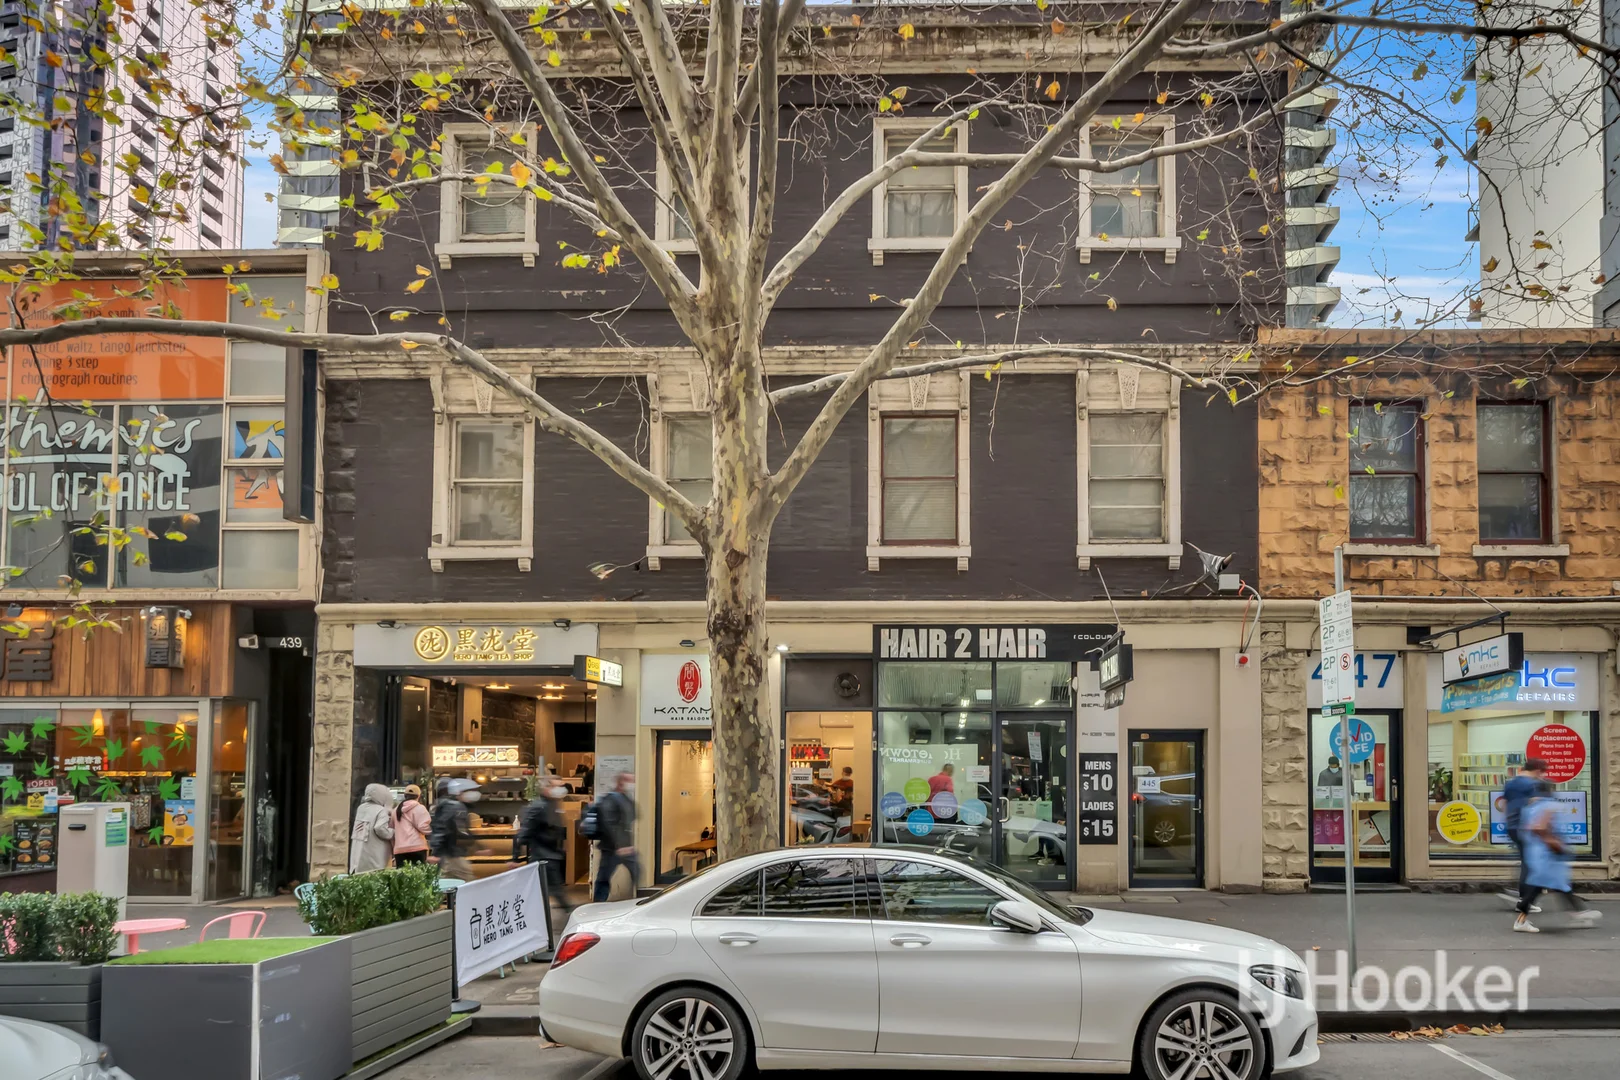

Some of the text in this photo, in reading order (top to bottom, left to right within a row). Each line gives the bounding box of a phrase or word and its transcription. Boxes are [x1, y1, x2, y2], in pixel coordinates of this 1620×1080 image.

[135, 340, 186, 355] quickstep
[75, 357, 99, 370] step
[94, 372, 138, 385] routines
[51, 471, 87, 512] OF
[1322, 599, 1332, 613] 1P
[1322, 625, 1335, 640] 2P
[280, 637, 302, 648] 439
[880, 628, 1047, 658] HAIR 2 HAIR
[1323, 655, 1336, 670] 2P
[1467, 646, 1499, 664] mkc
[1519, 660, 1576, 688] kc
[1516, 692, 1576, 702] REPAIRS
[1084, 761, 1111, 770] MENS
[31, 779, 54, 788] OPEN
[1083, 774, 1113, 791] $10
[1082, 801, 1114, 811] LADIES
[1083, 820, 1114, 836] $15
[483, 920, 527, 944] HERO TANG TEA
